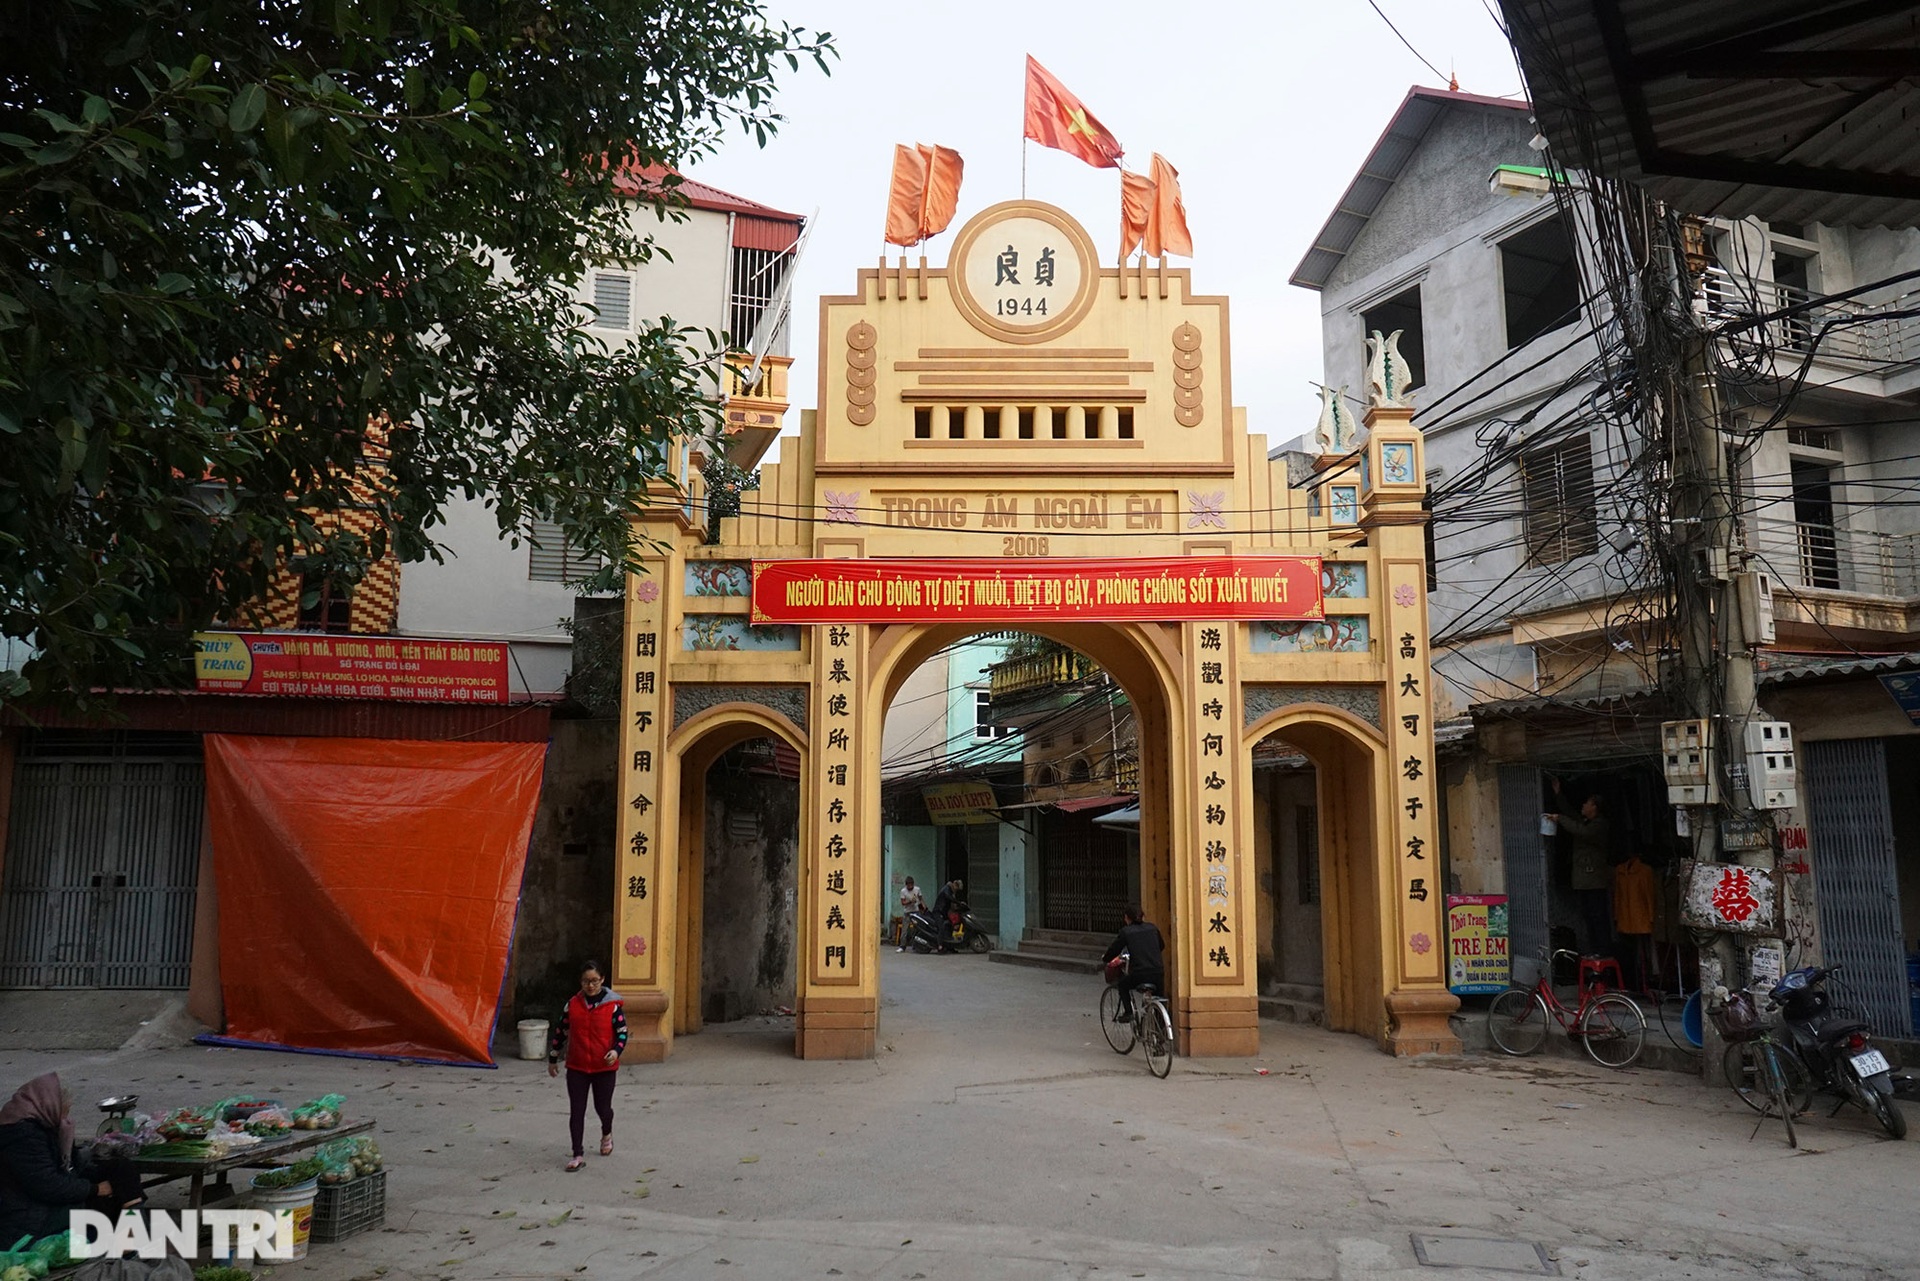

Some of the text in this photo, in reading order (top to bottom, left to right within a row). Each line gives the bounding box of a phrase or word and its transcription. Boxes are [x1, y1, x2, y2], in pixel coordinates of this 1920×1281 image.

[997, 297, 1048, 316] 1944
[881, 497, 967, 528] TRONG
[1126, 492, 1163, 529] ÊM
[1003, 536, 1050, 556] 2008
[786, 568, 1289, 612] NGƯỜI DÂN CHỦ ĐỘNG TỰ DIỆT MUỖI, DIỆT BỌ GẬY, PHÒNG CHỐNG SỐT XUẤT HUYẾT
[283, 639, 310, 655] VÀNG
[450, 644, 470, 661] BẢO
[473, 647, 500, 665] NGỌC
[203, 659, 246, 671] TRANG
[310, 682, 332, 694] LÀM
[390, 686, 414, 698] SINH
[451, 687, 470, 701] HỘI
[1451, 912, 1487, 933] Thời Trang
[1452, 931, 1507, 955] TRẺ EM
